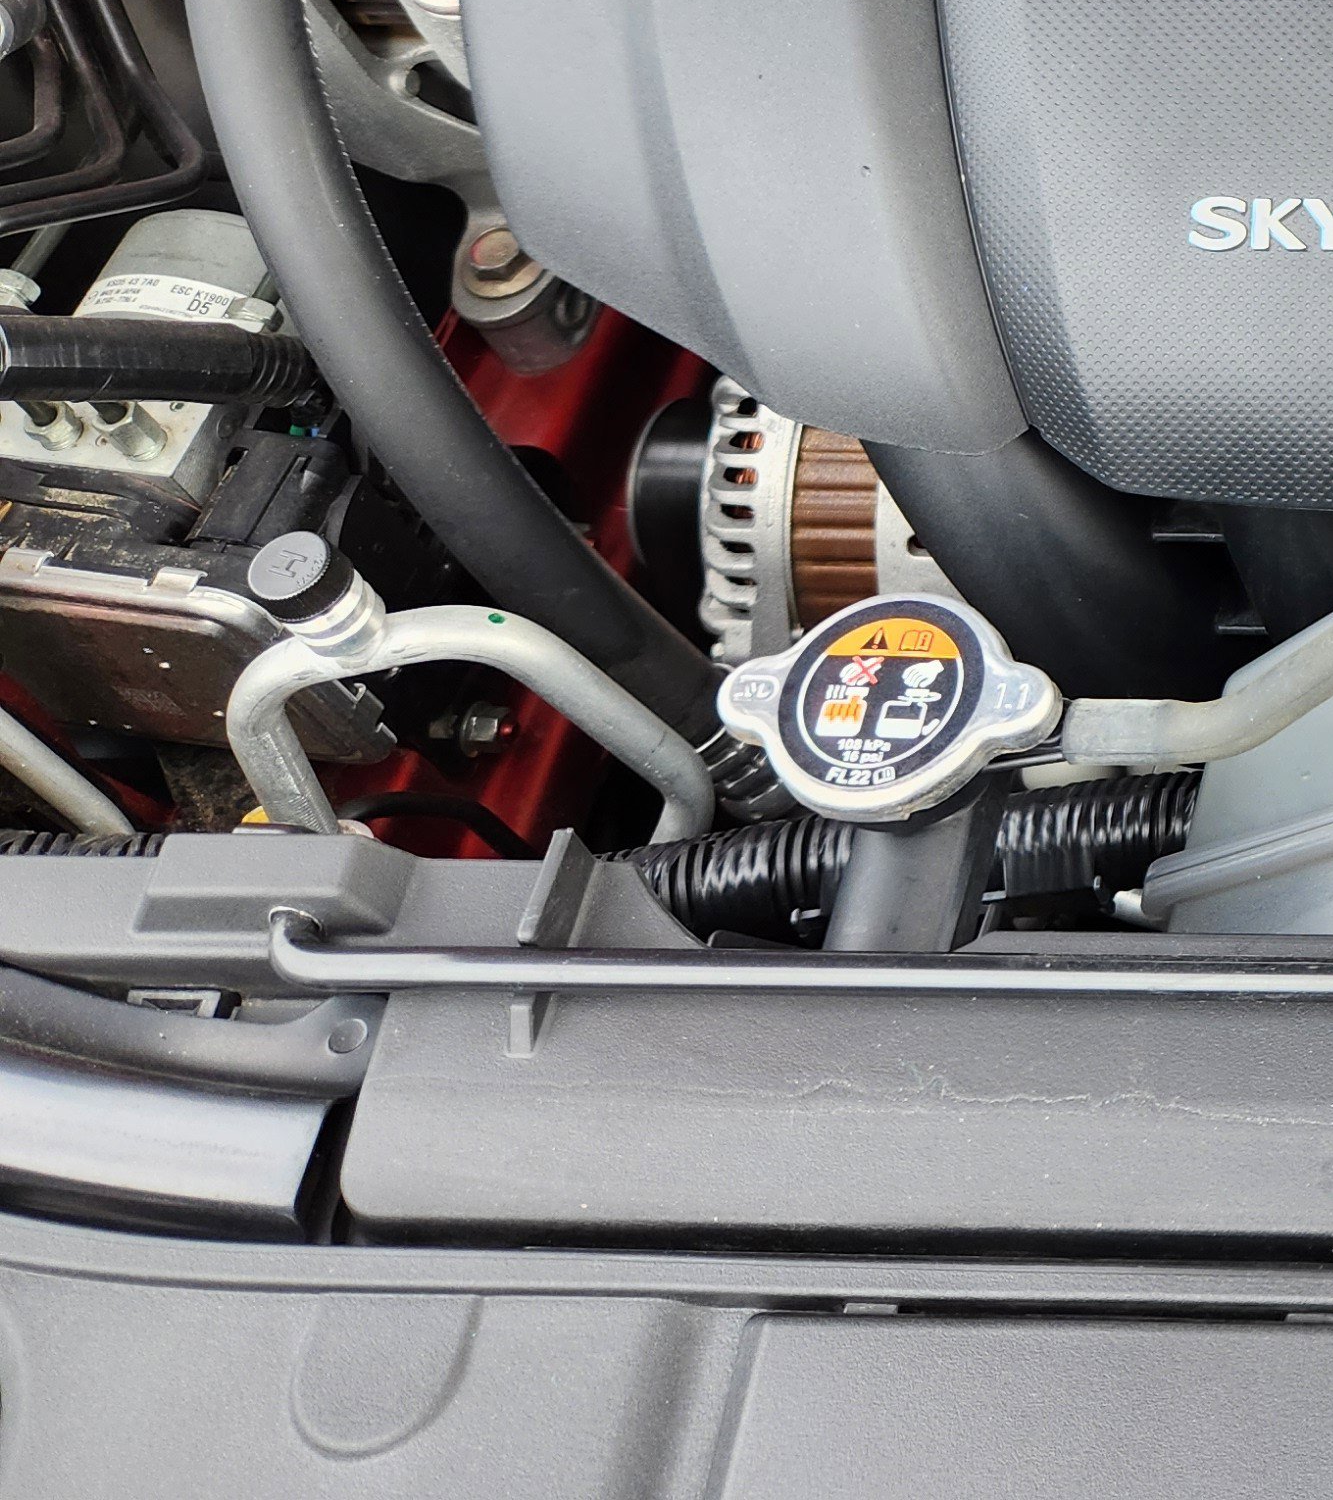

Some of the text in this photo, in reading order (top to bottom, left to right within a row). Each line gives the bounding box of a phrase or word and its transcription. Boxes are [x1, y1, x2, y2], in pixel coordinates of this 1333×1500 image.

[170, 284, 231, 306] ESC K1900
[186, 298, 213, 316] D5
[993, 682, 1030, 711] 1.1
[836, 738, 892, 752] 108 kPa
[841, 750, 884, 765] 16 psi
[824, 766, 872, 786] FL22
